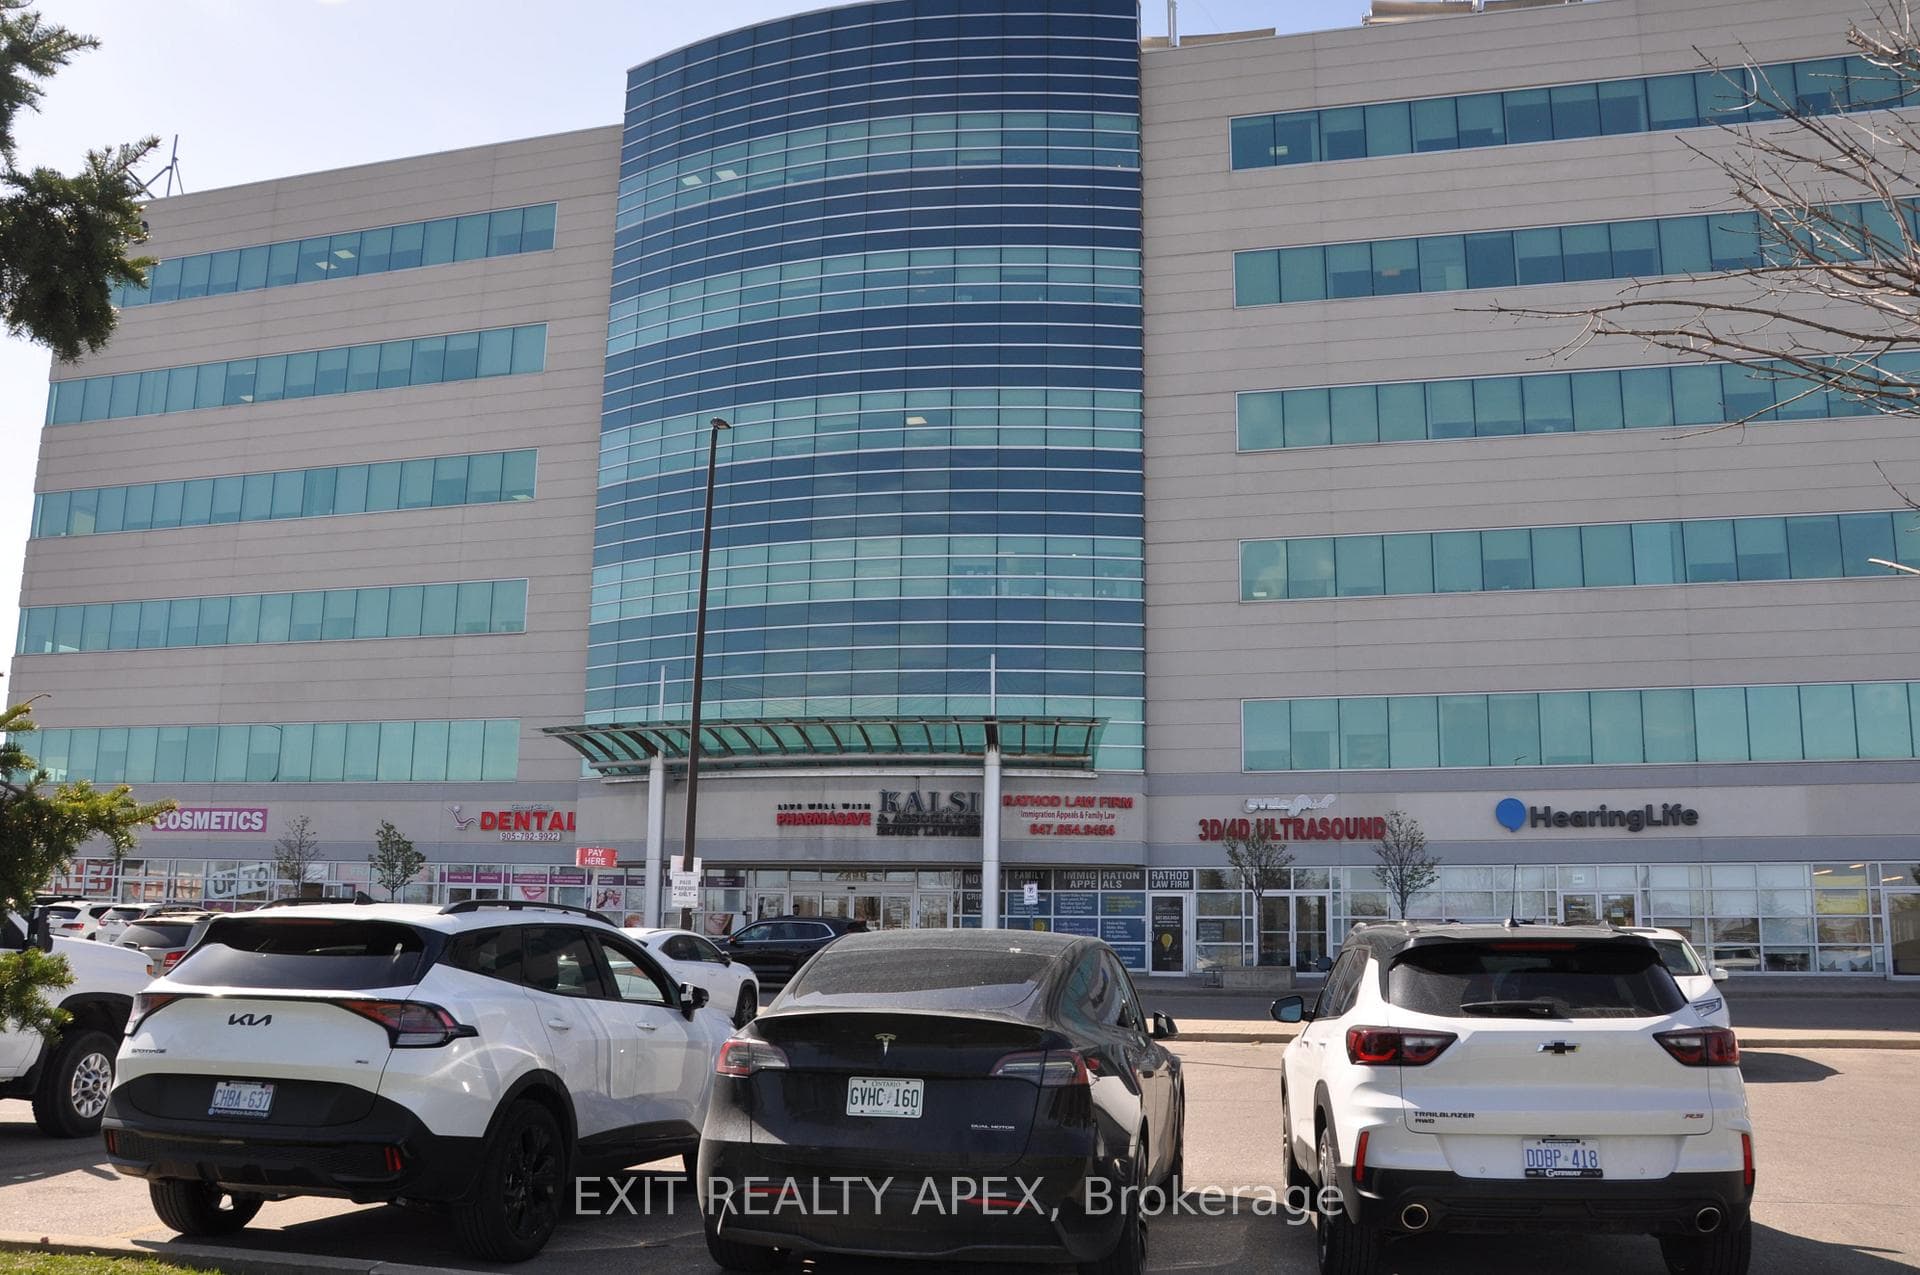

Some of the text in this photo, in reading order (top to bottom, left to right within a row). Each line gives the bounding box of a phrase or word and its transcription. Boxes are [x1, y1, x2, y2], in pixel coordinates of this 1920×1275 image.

[879, 790, 982, 814] KALSI
[1065, 796, 1096, 808] LAW
[1099, 797, 1133, 809] FIRM
[156, 811, 264, 831] COSMETICS
[480, 811, 576, 831] DENTAL
[777, 812, 872, 826] PHARMASAVE
[1021, 810, 1055, 820] Immigration
[1056, 811, 1079, 821] Appeals
[1085, 811, 1103, 820] Family
[1530, 803, 1699, 832] HearingLife
[1199, 816, 1387, 842] 3D/4D ULTRASOUND
[584, 857, 607, 866] HERE
[587, 849, 604, 857] PAY
[212, 873, 236, 894] UP
[246, 865, 269, 888] TO
[1151, 871, 1189, 880] RATHOD
[1151, 880, 1190, 889] LAW FIRM
[228, 1014, 272, 1026] KIA
[213, 1089, 271, 1109] CHBA 637
[850, 1087, 919, 1108] GVHC 160
[1526, 1149, 1598, 1168] DDBP 418
